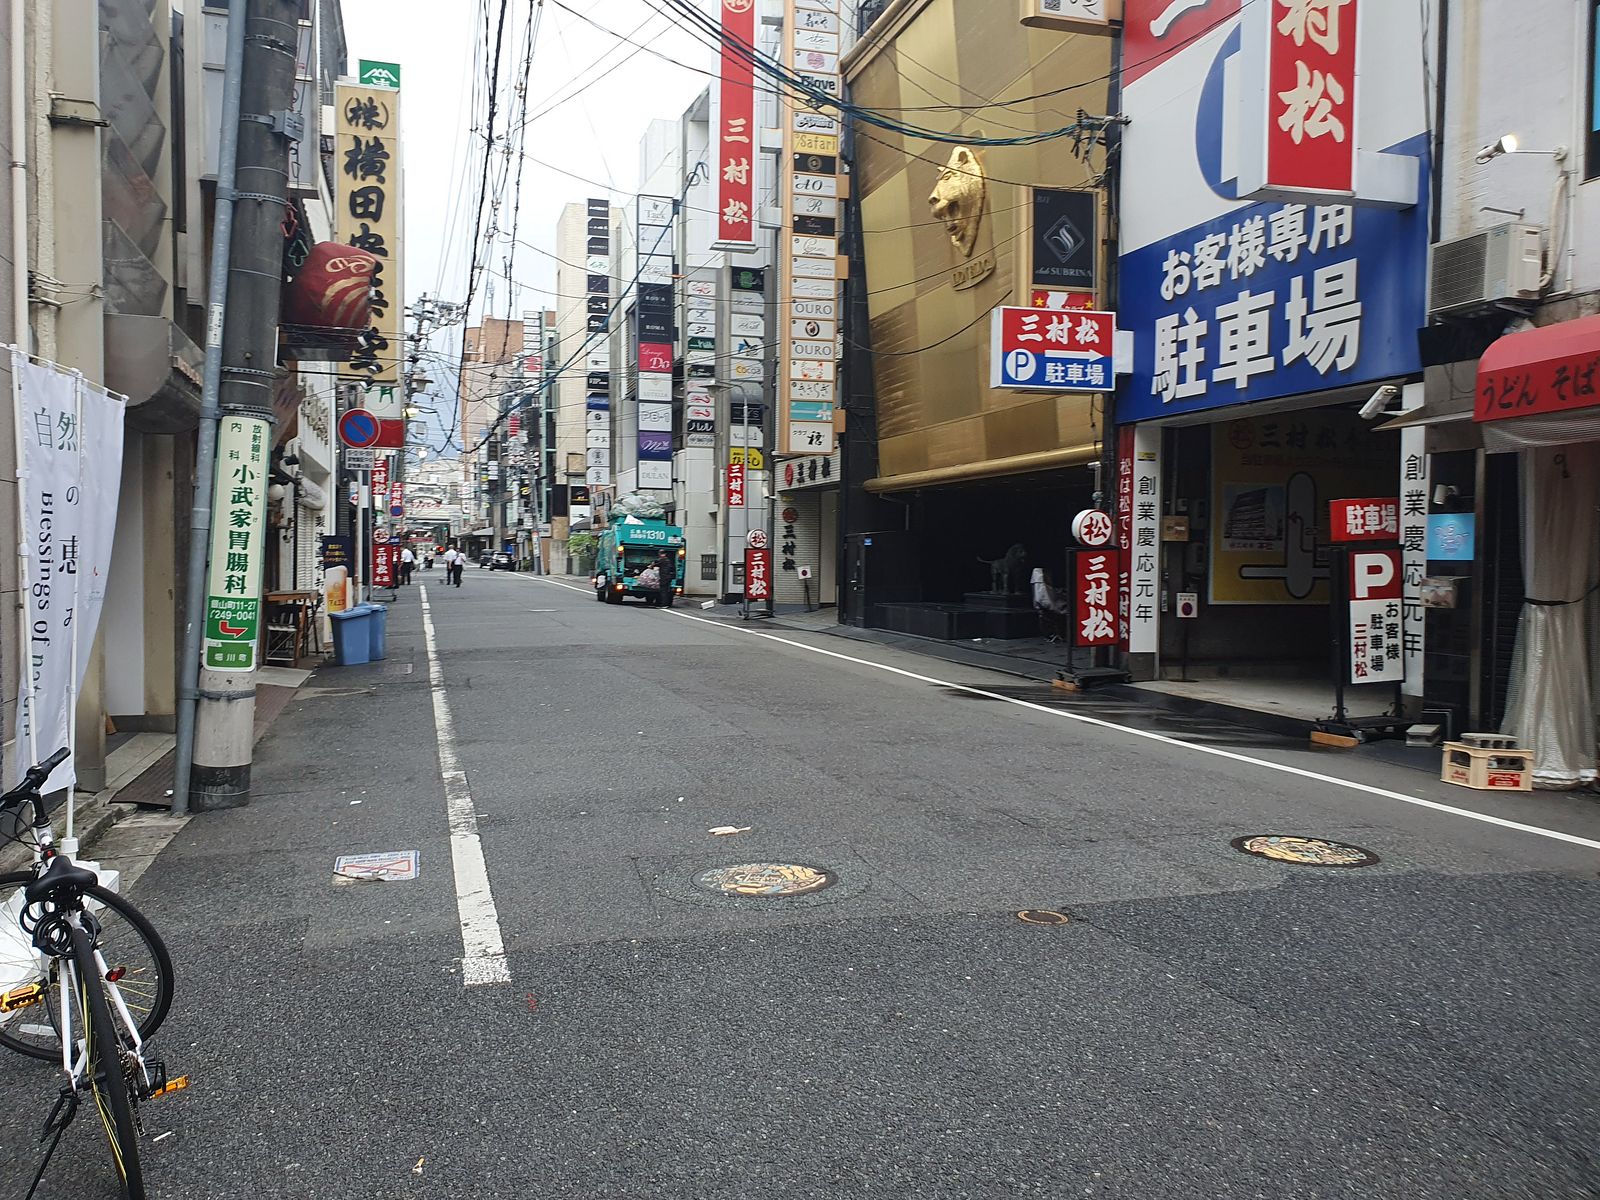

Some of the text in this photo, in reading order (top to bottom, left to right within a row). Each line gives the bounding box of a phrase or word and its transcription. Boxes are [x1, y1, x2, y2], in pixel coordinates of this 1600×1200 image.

[800, 136, 836, 151] Safari
[723, 118, 750, 225] 三村松
[1160, 204, 1353, 301] お客様専用
[795, 303, 833, 315] OURO
[1017, 313, 1100, 345] 三村松
[1151, 258, 1362, 404] 駐車場
[795, 344, 832, 356] OURO
[1045, 362, 1105, 385] 駐車場
[1483, 372, 1538, 415] うどん
[1552, 355, 1600, 401] そば
[228, 422, 242, 461] 内科
[250, 424, 263, 463] 放射線科
[729, 464, 744, 505] 三村松
[1118, 457, 1132, 550] 松は松でも
[224, 464, 254, 595] 小武家胃腸科
[647, 530, 666, 540] 1310
[1083, 516, 1110, 542] 松
[1345, 504, 1398, 536] 駐車場
[32, 490, 54, 612] Blessings
[1135, 475, 1157, 624] 創業慶応元年
[1403, 453, 1427, 659] 創業慶応元年
[749, 552, 768, 597] 三村松
[1354, 552, 1395, 599] P
[1081, 555, 1115, 643] 三村松
[31, 620, 51, 649] of
[1353, 623, 1369, 679] 三村松
[1370, 613, 1385, 672] 駐車場
[1385, 601, 1400, 660] お客様
